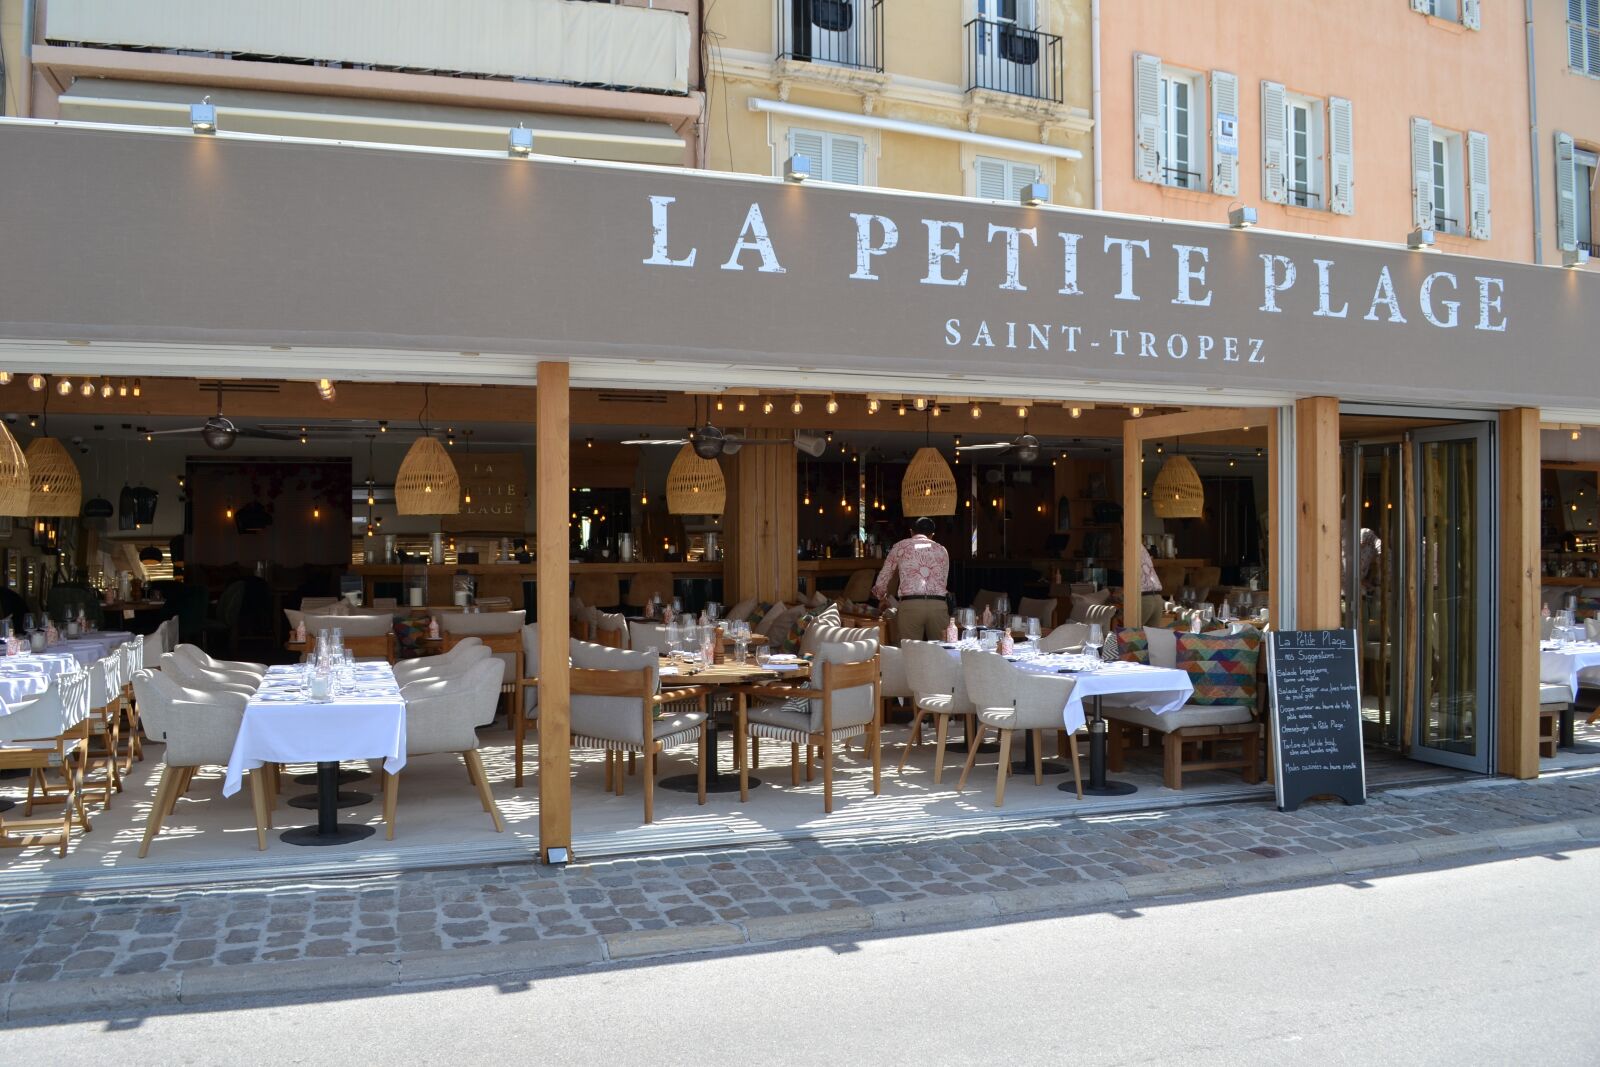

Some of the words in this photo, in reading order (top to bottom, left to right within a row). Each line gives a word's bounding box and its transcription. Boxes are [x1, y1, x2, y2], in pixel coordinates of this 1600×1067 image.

[642, 195, 787, 274] LA
[849, 212, 1212, 306] PETITE
[1258, 253, 1508, 332] PLAGE
[1278, 634, 1291, 647] La
[1296, 630, 1316, 647] Petite
[1322, 630, 1347, 649] Plage
[1276, 667, 1297, 677] Salade
[1278, 687, 1298, 695] Salade
